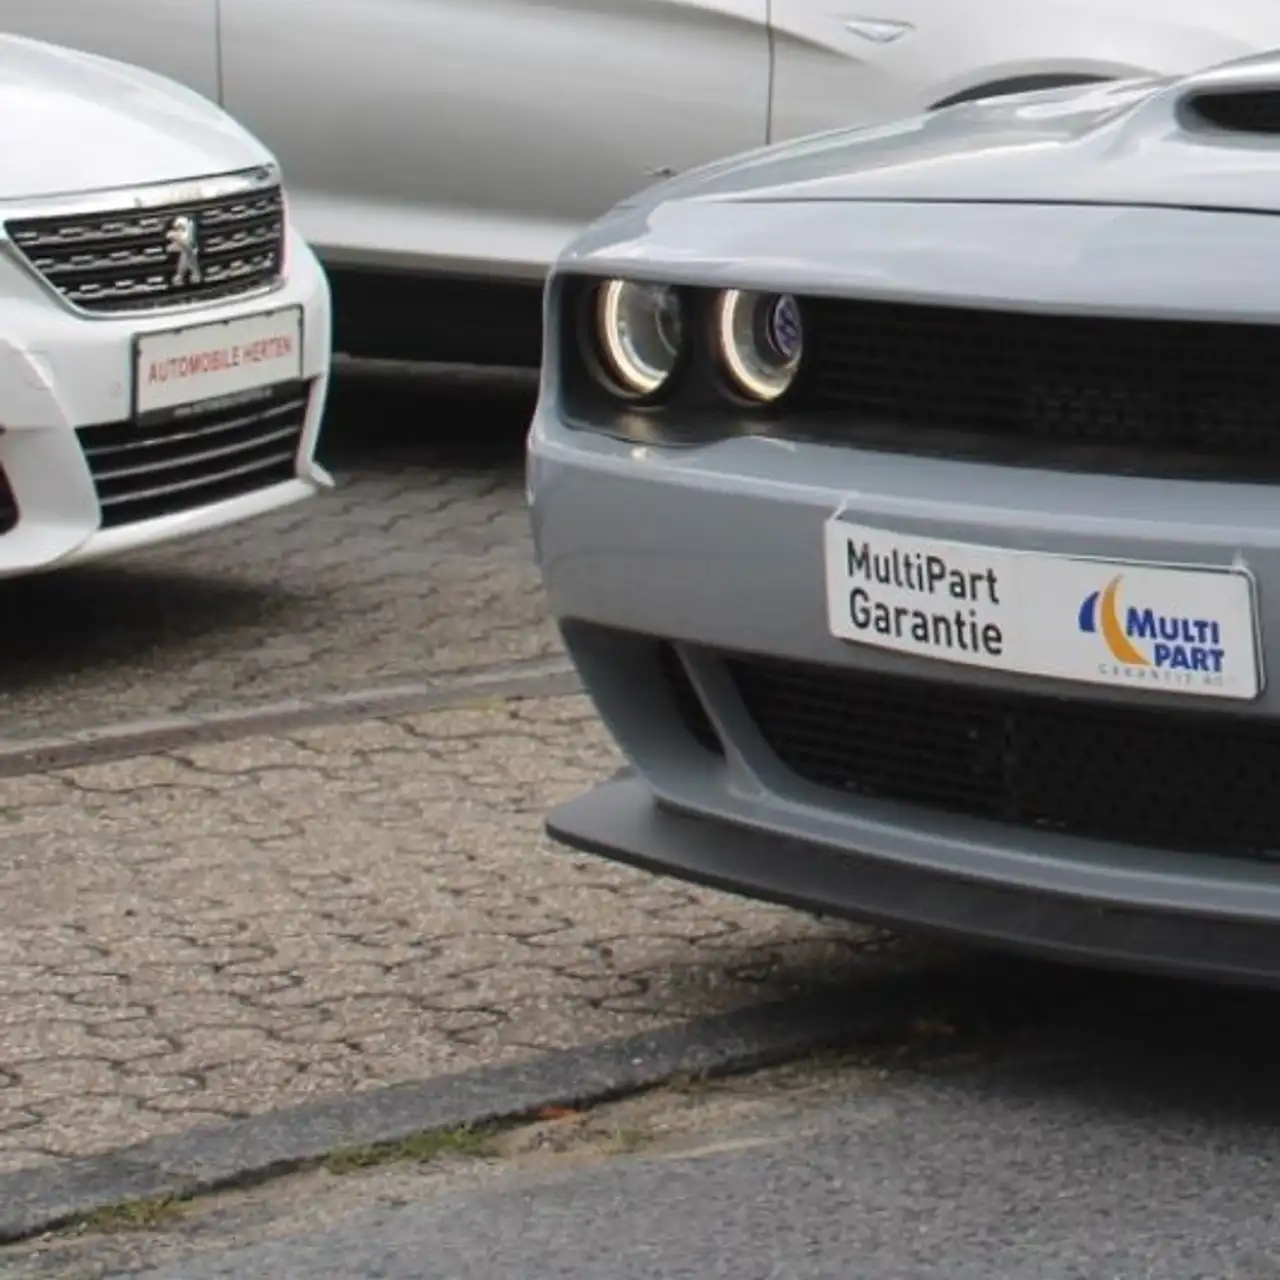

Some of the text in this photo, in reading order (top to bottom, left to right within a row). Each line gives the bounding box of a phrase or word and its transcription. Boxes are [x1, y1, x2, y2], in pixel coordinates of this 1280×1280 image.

[148, 345, 241, 381] AUTOMOBILE
[847, 538, 1000, 604] MultiPart
[850, 587, 1003, 656] Garantie
[1127, 607, 1220, 645] MULTI
[1154, 643, 1226, 673] PART
